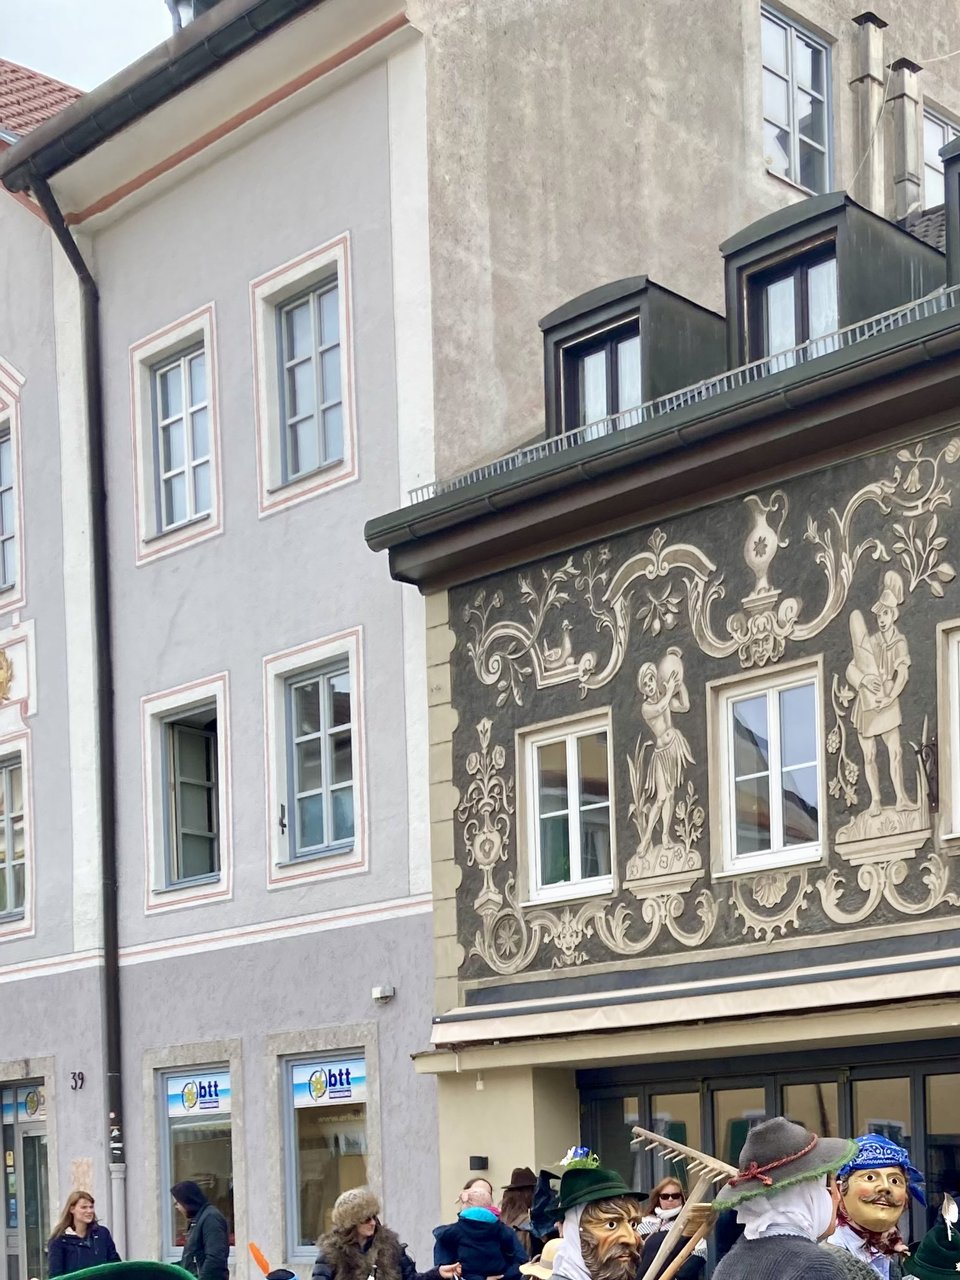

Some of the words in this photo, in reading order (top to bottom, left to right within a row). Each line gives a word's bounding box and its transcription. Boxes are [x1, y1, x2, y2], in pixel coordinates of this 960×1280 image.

[70, 1071, 85, 1091] 39
[328, 1068, 351, 1087] btt
[198, 1080, 219, 1098] btt
